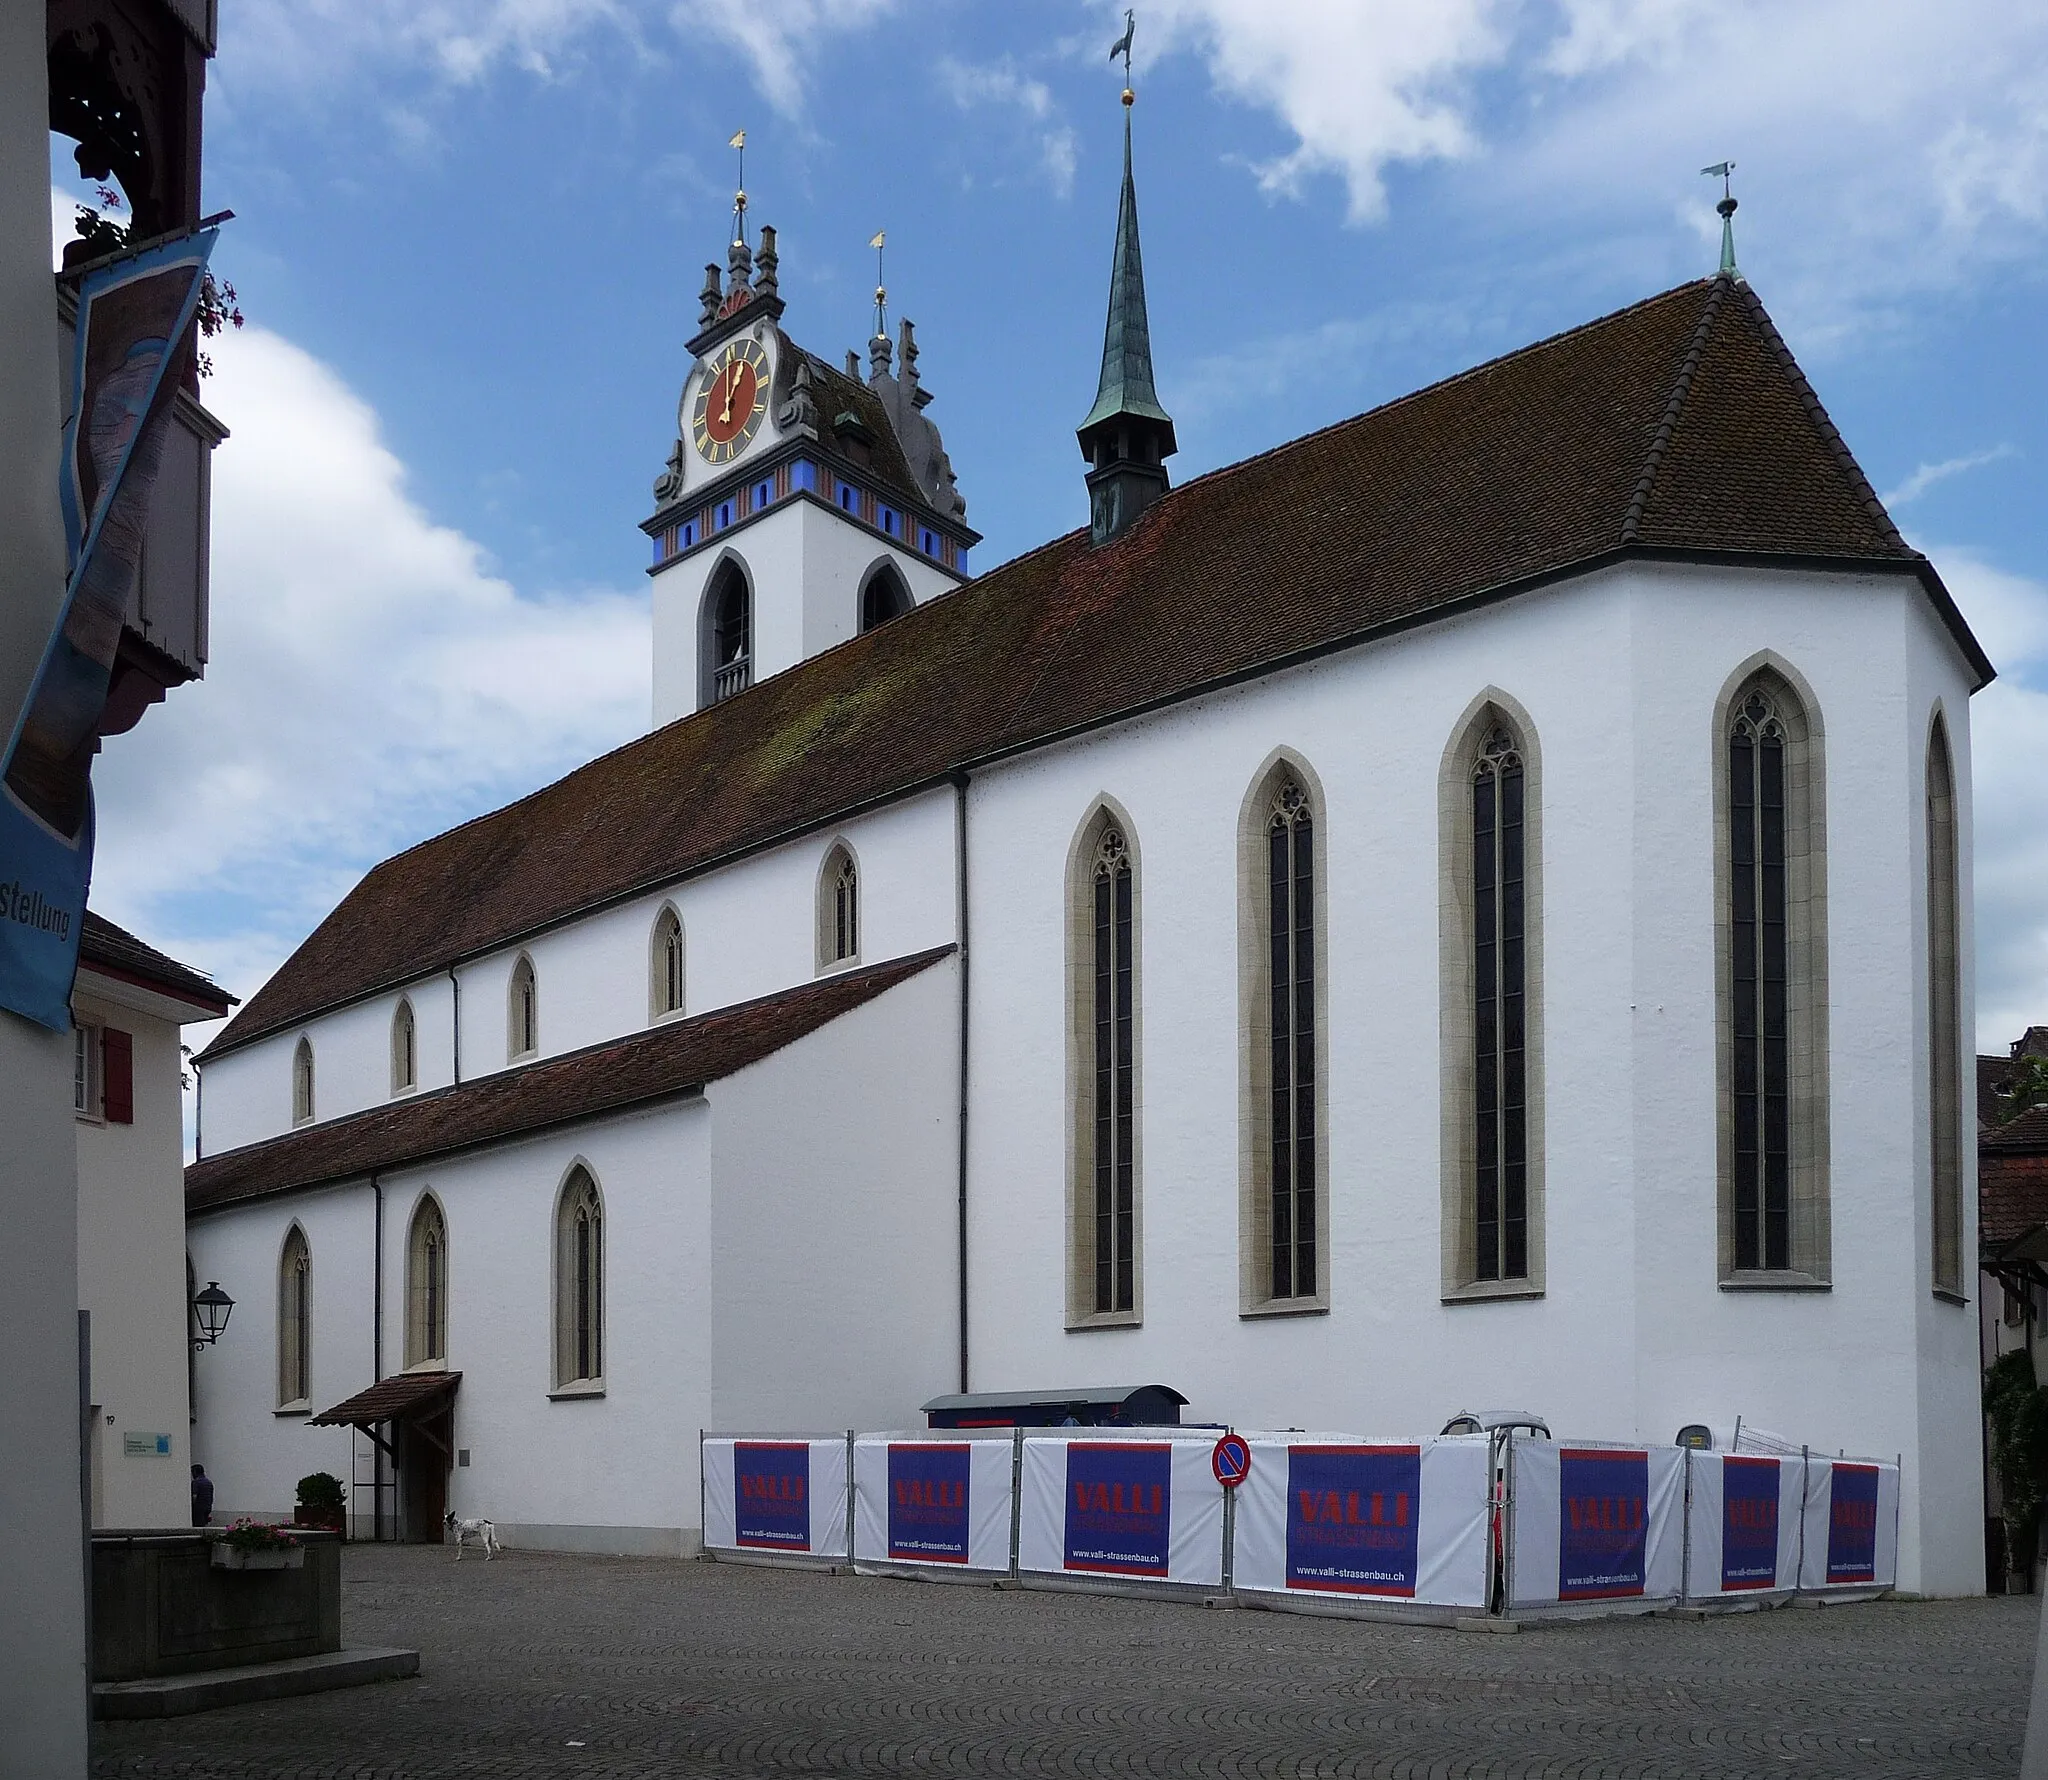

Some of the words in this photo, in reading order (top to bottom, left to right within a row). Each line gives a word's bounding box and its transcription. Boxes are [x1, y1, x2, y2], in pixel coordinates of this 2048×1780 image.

[106, 1415, 116, 1426] 19
[741, 1474, 804, 1502] VALLI
[895, 1480, 963, 1507] VALLI
[1075, 1481, 1162, 1514] VALLI
[1299, 1490, 1409, 1527] VALLI
[1568, 1496, 1642, 1531] VALLI
[741, 1530, 804, 1540] www.valli-strassenbau.ch
[894, 1540, 962, 1552] www.valli-strassenbau.ch
[1072, 1549, 1160, 1563] www.valli-strassenbau.ch
[1296, 1566, 1405, 1581] www.valli-strassenbau.ch
[1567, 1572, 1638, 1586] www.valli-strassenbau.ch
